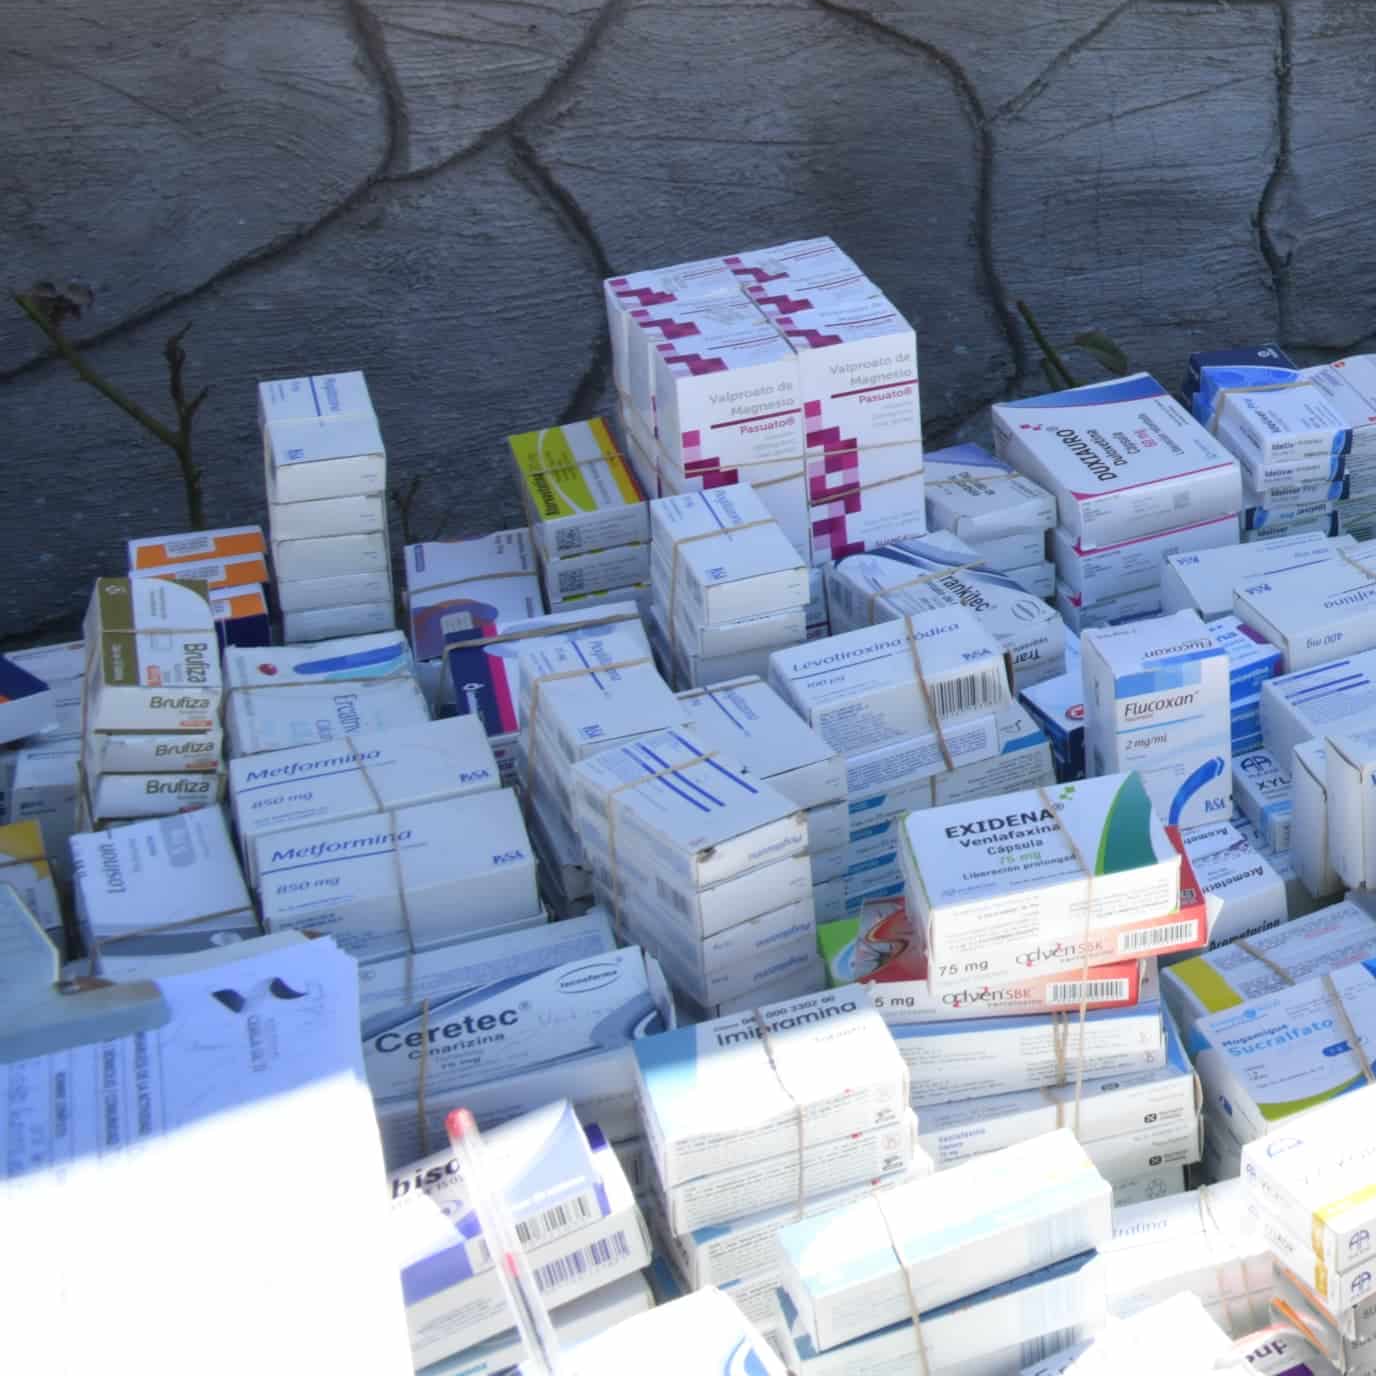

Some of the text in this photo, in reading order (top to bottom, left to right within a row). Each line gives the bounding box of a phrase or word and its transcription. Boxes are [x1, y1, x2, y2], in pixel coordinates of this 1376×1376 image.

[828, 352, 911, 377] Valproato de
[849, 368, 912, 386] Magnesio
[709, 381, 794, 407] Valproato de
[730, 398, 795, 416] Magnesio
[183, 642, 208, 685] Brufiza
[149, 695, 210, 710] Brufiza
[1123, 690, 1200, 717] Flucoxan
[155, 740, 215, 757] Brufiza
[246, 747, 382, 782] Metformina
[145, 778, 210, 794] Brufiza
[944, 808, 1054, 840] EXIDENA
[959, 822, 1062, 848] Venlafaxina
[270, 827, 413, 863] Metformina
[939, 959, 990, 976] 75 mg
[889, 994, 915, 1010] mg
[375, 1007, 520, 1055] Ceretec
[717, 1001, 856, 1046] Imipramina
[408, 1033, 505, 1061] Cnarizina
[1229, 1018, 1334, 1056] Sucralfato
